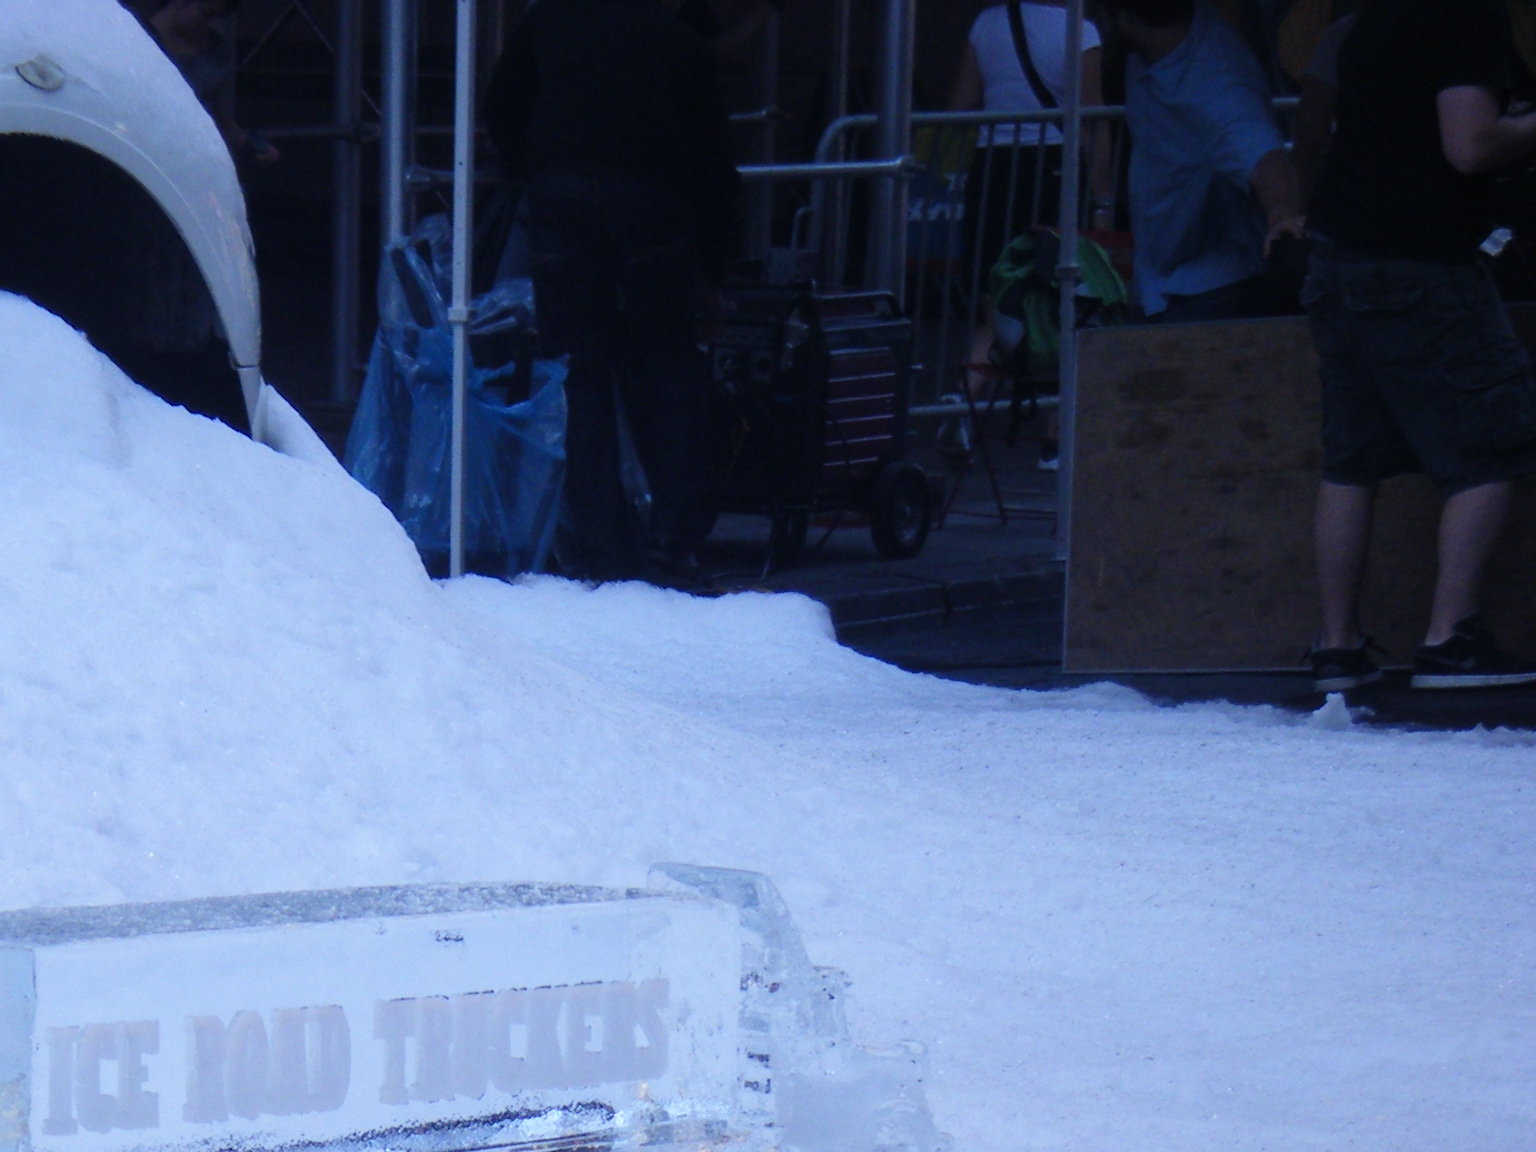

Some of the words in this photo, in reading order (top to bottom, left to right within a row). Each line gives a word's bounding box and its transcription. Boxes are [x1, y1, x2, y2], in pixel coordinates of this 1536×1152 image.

[42, 1019, 160, 1135] ICE
[182, 1004, 352, 1123] ROAD
[372, 977, 671, 1105] TRUCKERS
